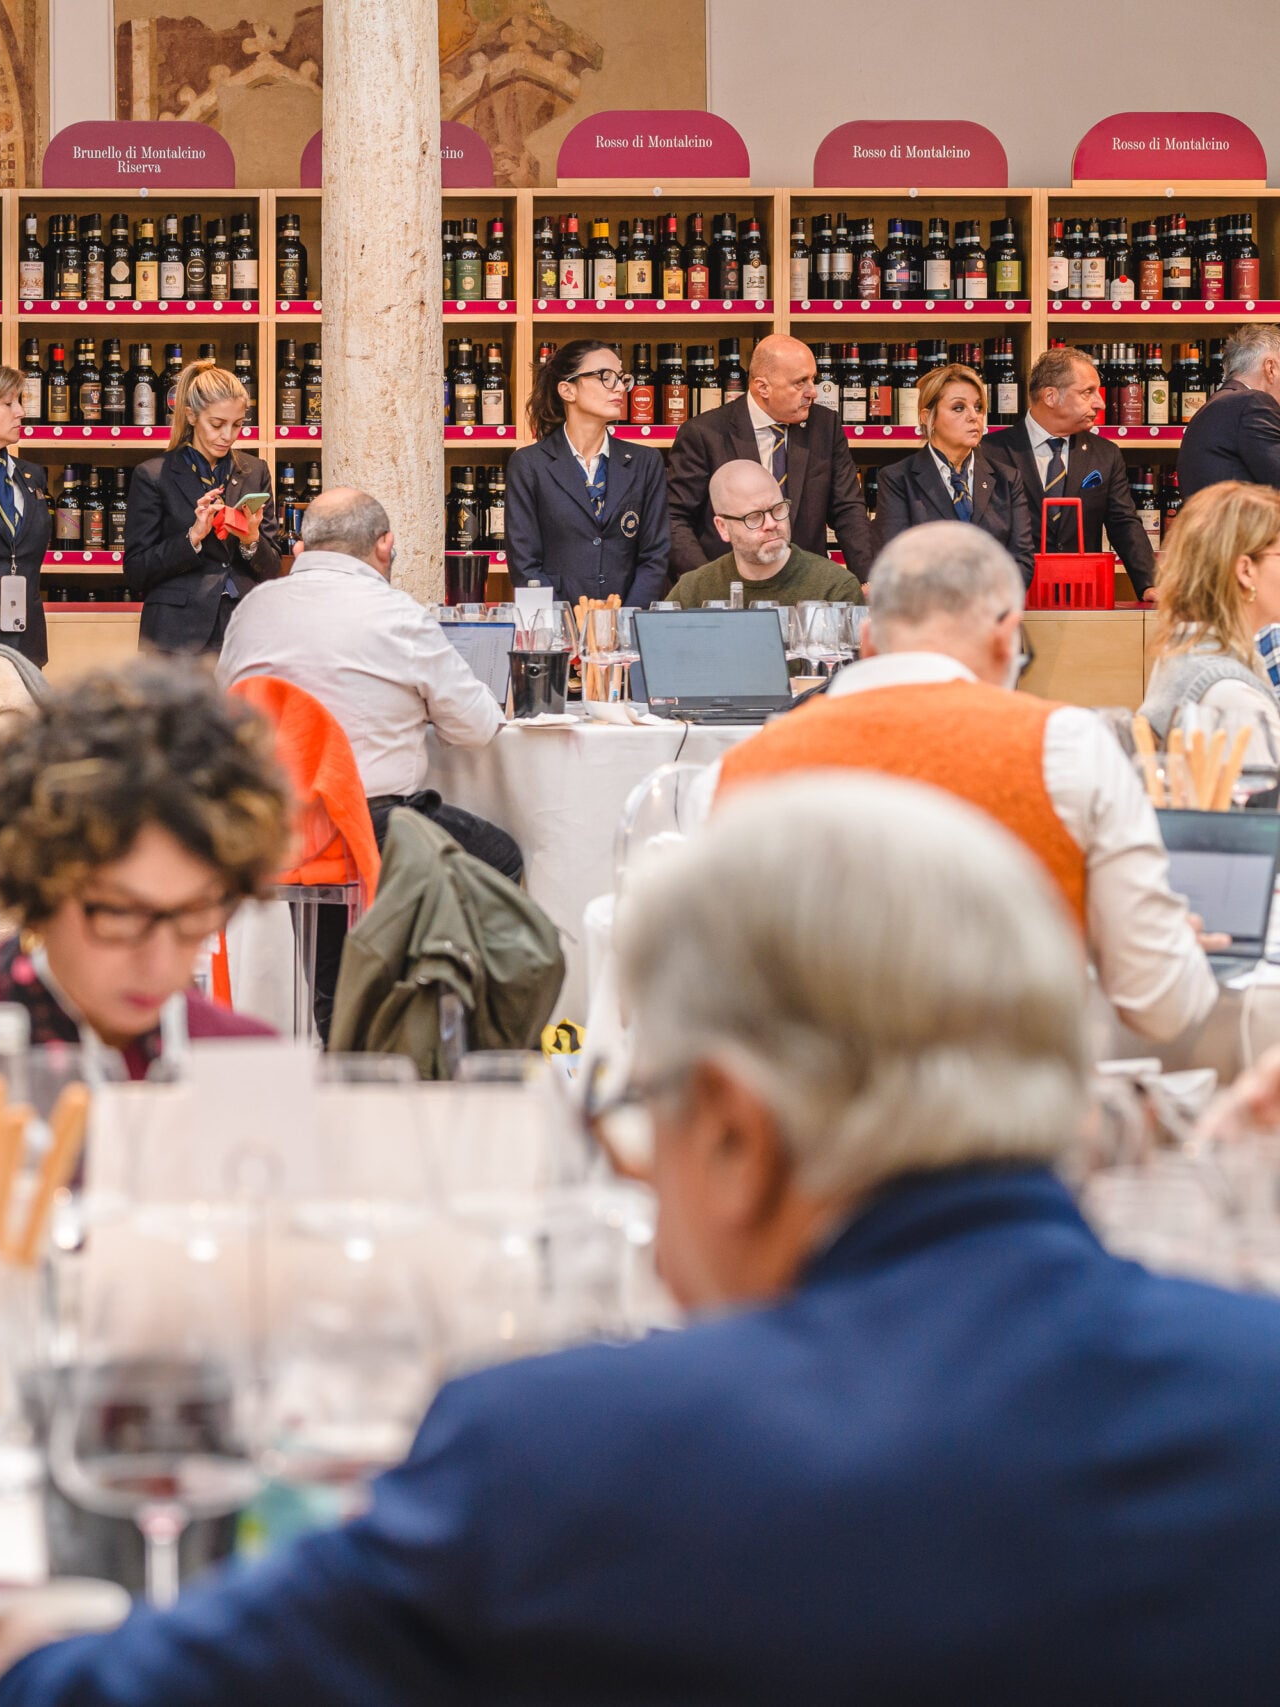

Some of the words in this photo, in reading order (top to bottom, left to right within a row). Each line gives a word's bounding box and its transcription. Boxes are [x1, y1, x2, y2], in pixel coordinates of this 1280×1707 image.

[596, 136, 628, 148] Rosso
[632, 136, 644, 148] di
[648, 136, 712, 148] Montalcino
[1112, 137, 1146, 150] Rosso
[1149, 137, 1160, 150] di
[1164, 137, 1230, 150] Montalcino
[73, 146, 122, 159] Brunello
[126, 146, 136, 159] di
[142, 146, 206, 159] Montalcino
[440, 146, 464, 159] cino
[852, 145, 886, 158] Rosso
[890, 145, 901, 158] di
[905, 145, 970, 158] Montalcino
[118, 160, 161, 173] Riserva
